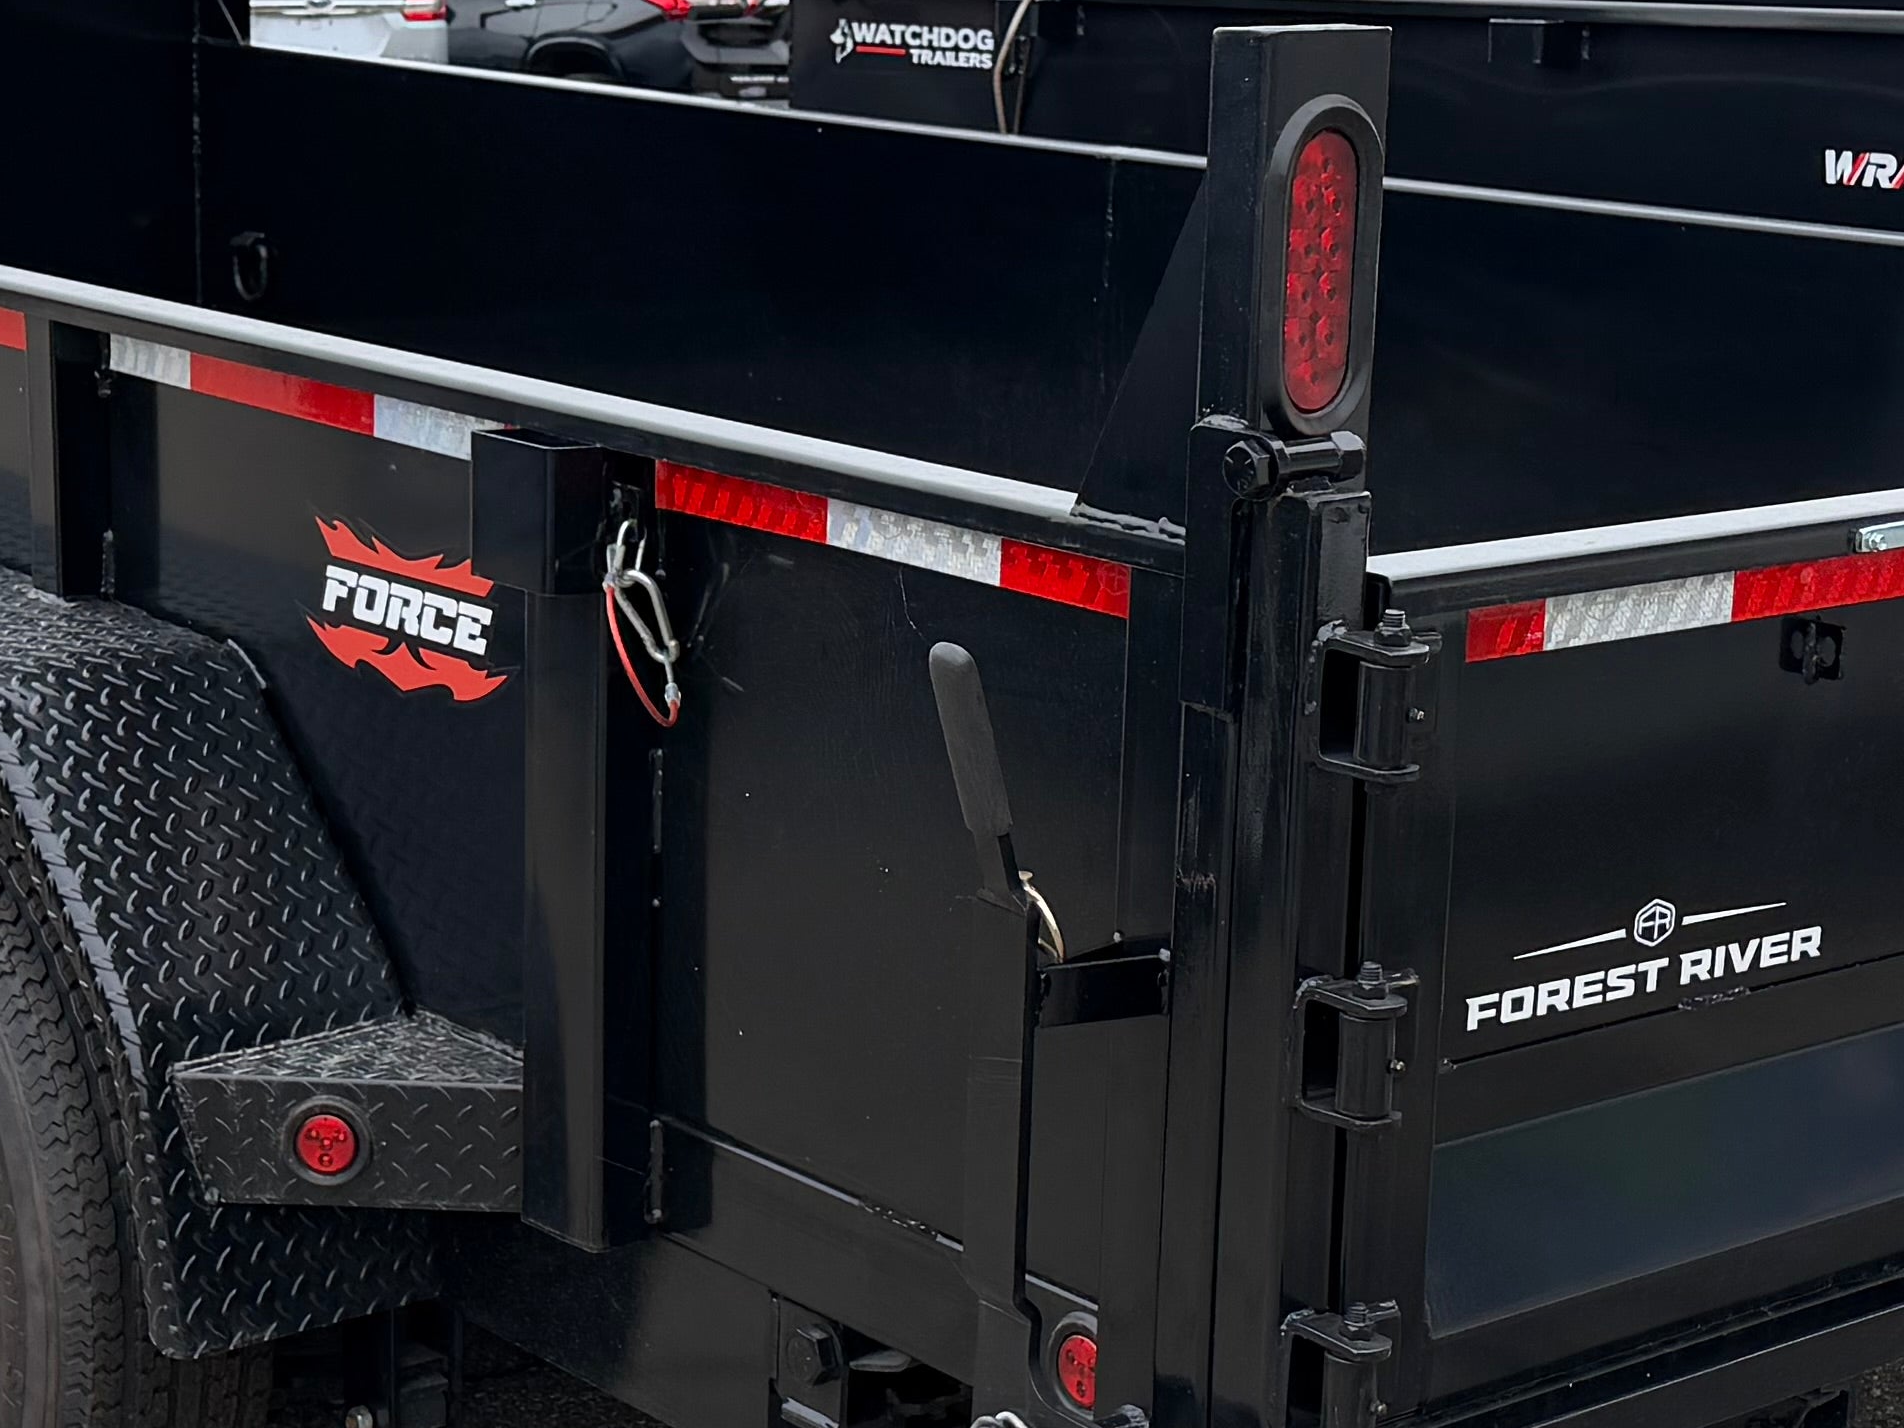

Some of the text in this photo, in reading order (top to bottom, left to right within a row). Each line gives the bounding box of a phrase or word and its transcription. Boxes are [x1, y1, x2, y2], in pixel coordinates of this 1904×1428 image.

[851, 22, 995, 51] WATCHDOG
[909, 49, 994, 69] TRAILERS
[322, 564, 494, 656] FORCE
[1465, 925, 1823, 1032] FOREST RIVER
